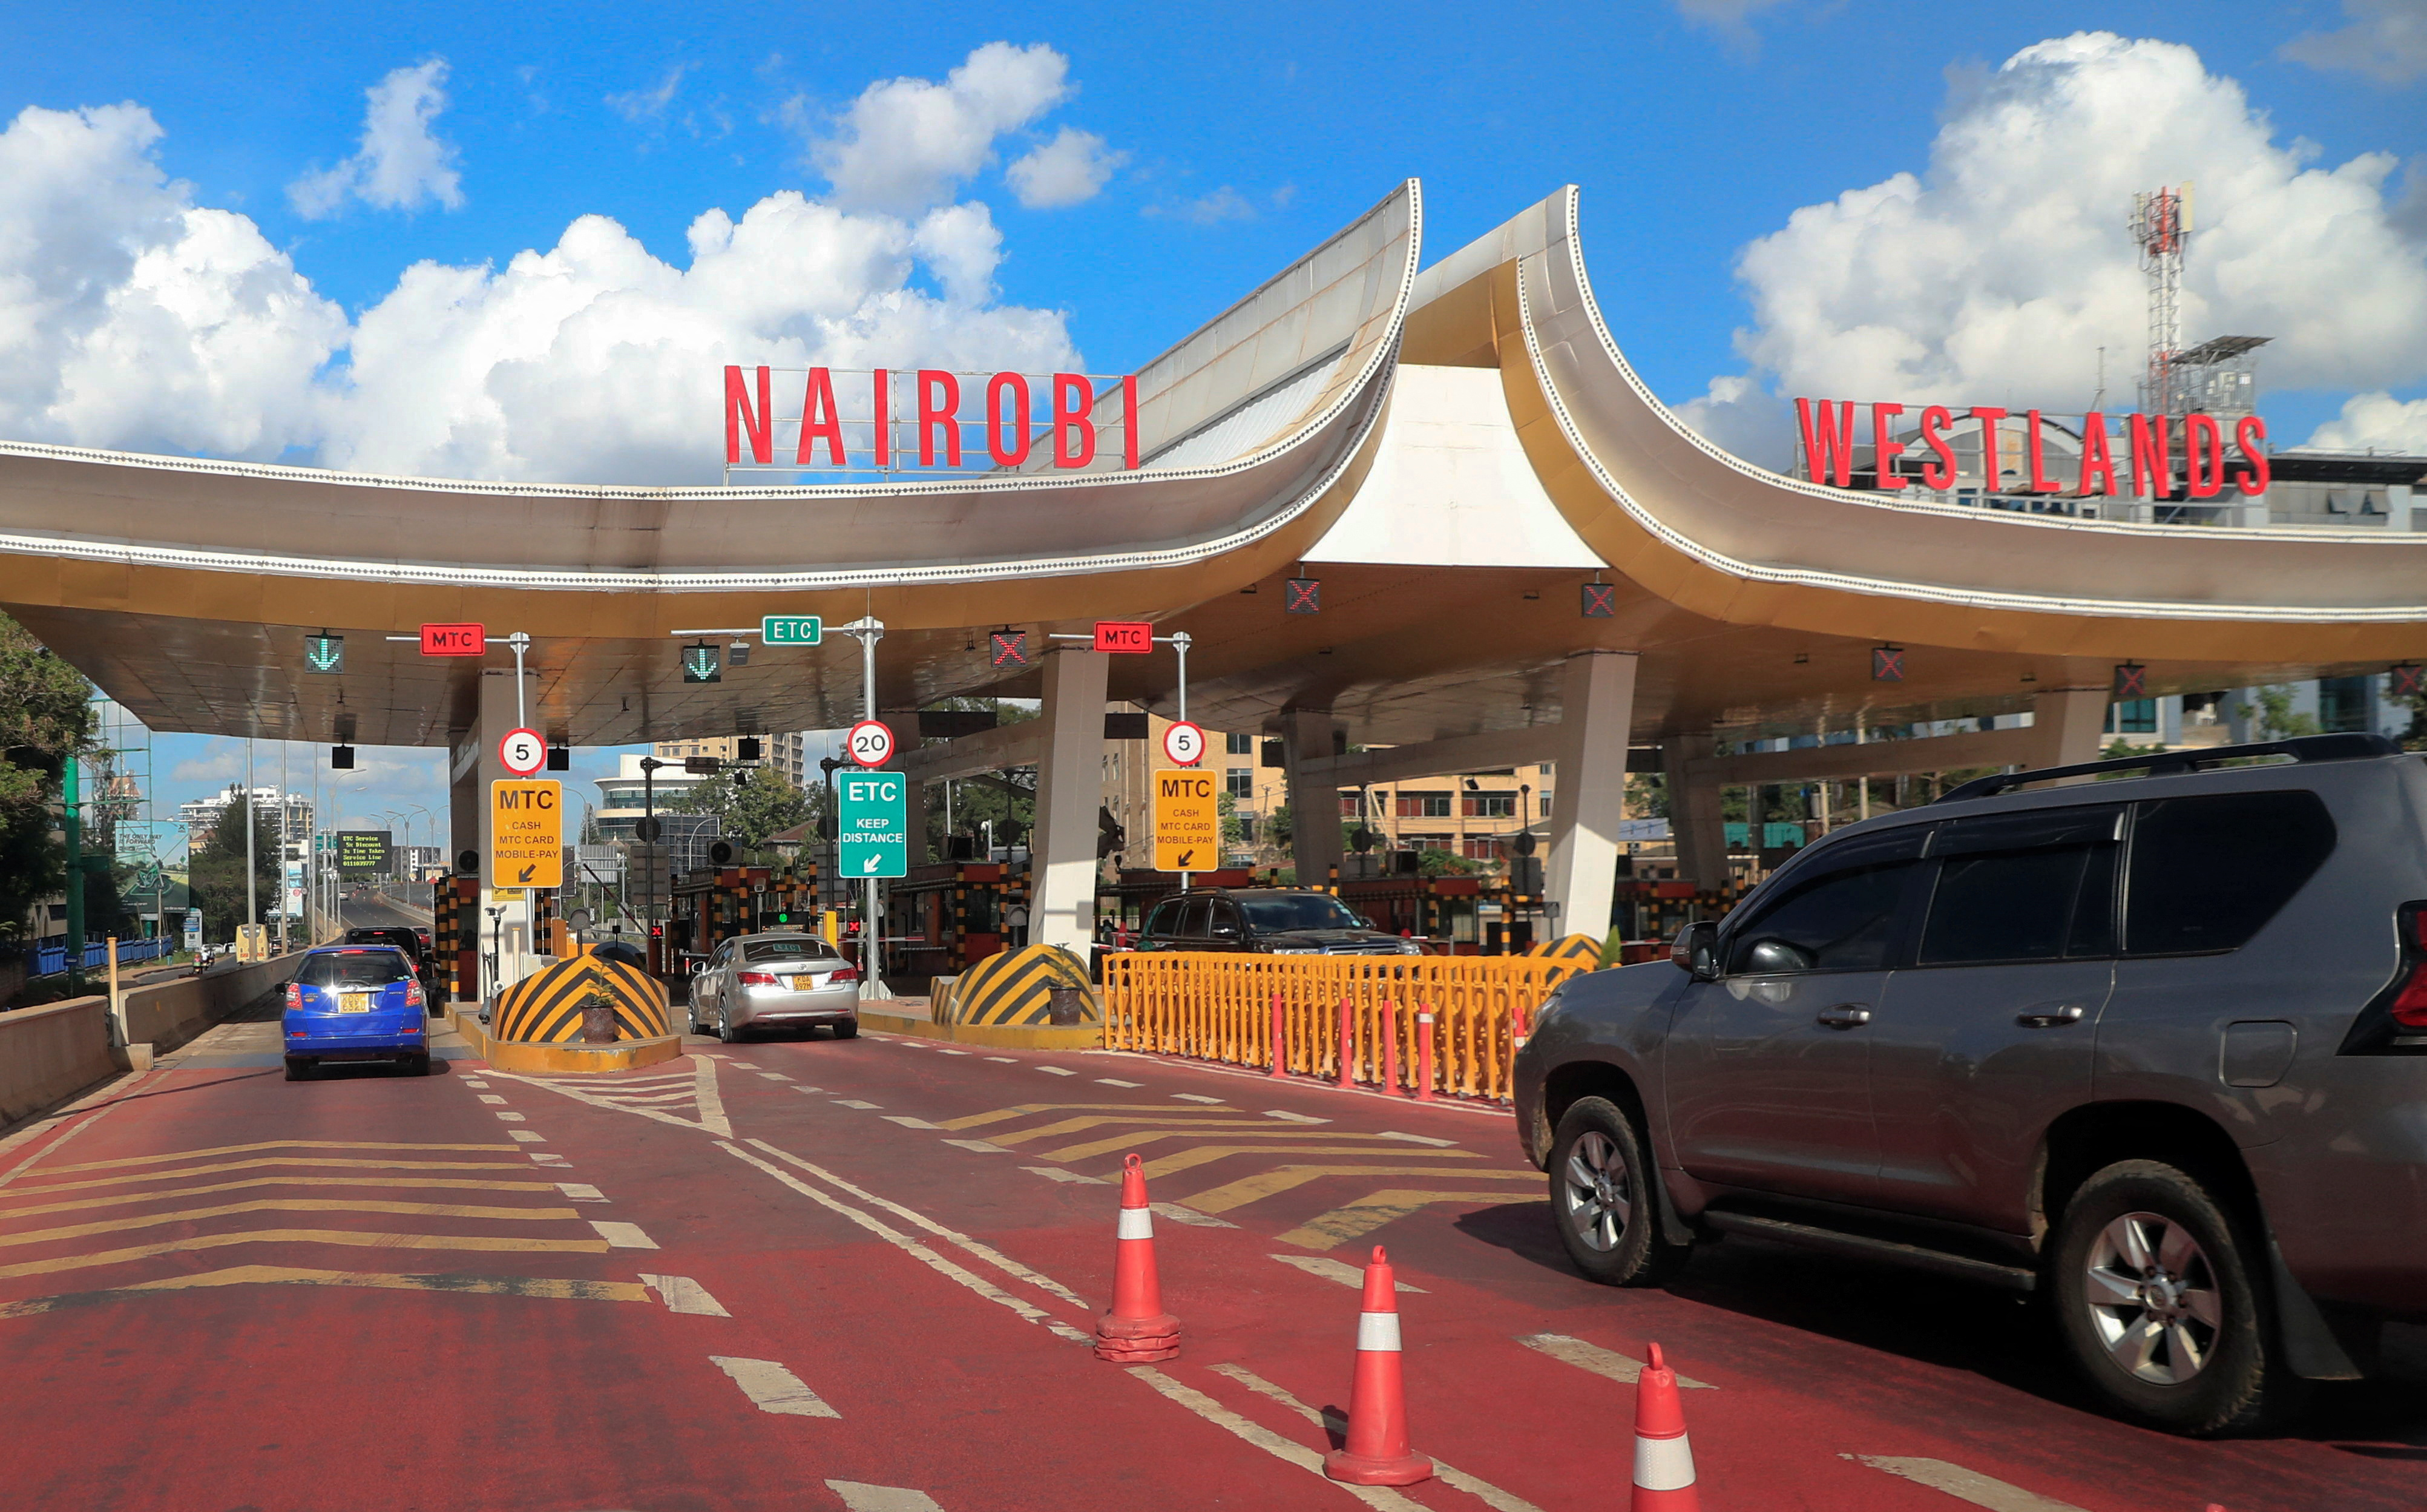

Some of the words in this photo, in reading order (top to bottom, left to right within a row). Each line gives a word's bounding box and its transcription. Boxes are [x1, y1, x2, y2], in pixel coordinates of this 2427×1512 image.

[725, 365, 1139, 470] NAIROBI
[1793, 397, 2271, 499] WESTLANDS
[773, 622, 811, 639] ETC
[1105, 630, 1141, 644] MTC
[433, 632, 472, 646] MTC
[856, 734, 885, 752] 20
[1178, 735, 1191, 751] 5
[515, 744, 529, 761] 5
[849, 782, 897, 802] ETC
[1162, 779, 1210, 798] MTC
[500, 790, 553, 809] MTC
[1173, 809, 1199, 817] CASH
[512, 821, 541, 830] CASH
[856, 818, 889, 829] KEEP
[1161, 822, 1181, 830] MTC
[1184, 822, 1210, 830] CARD
[499, 835, 521, 844] MTC
[525, 835, 554, 844] CARD
[842, 833, 903, 843] DISTANCE
[1157, 836, 1214, 844] MOBILE-PAY
[496, 850, 559, 859] MOBILE-PAY
